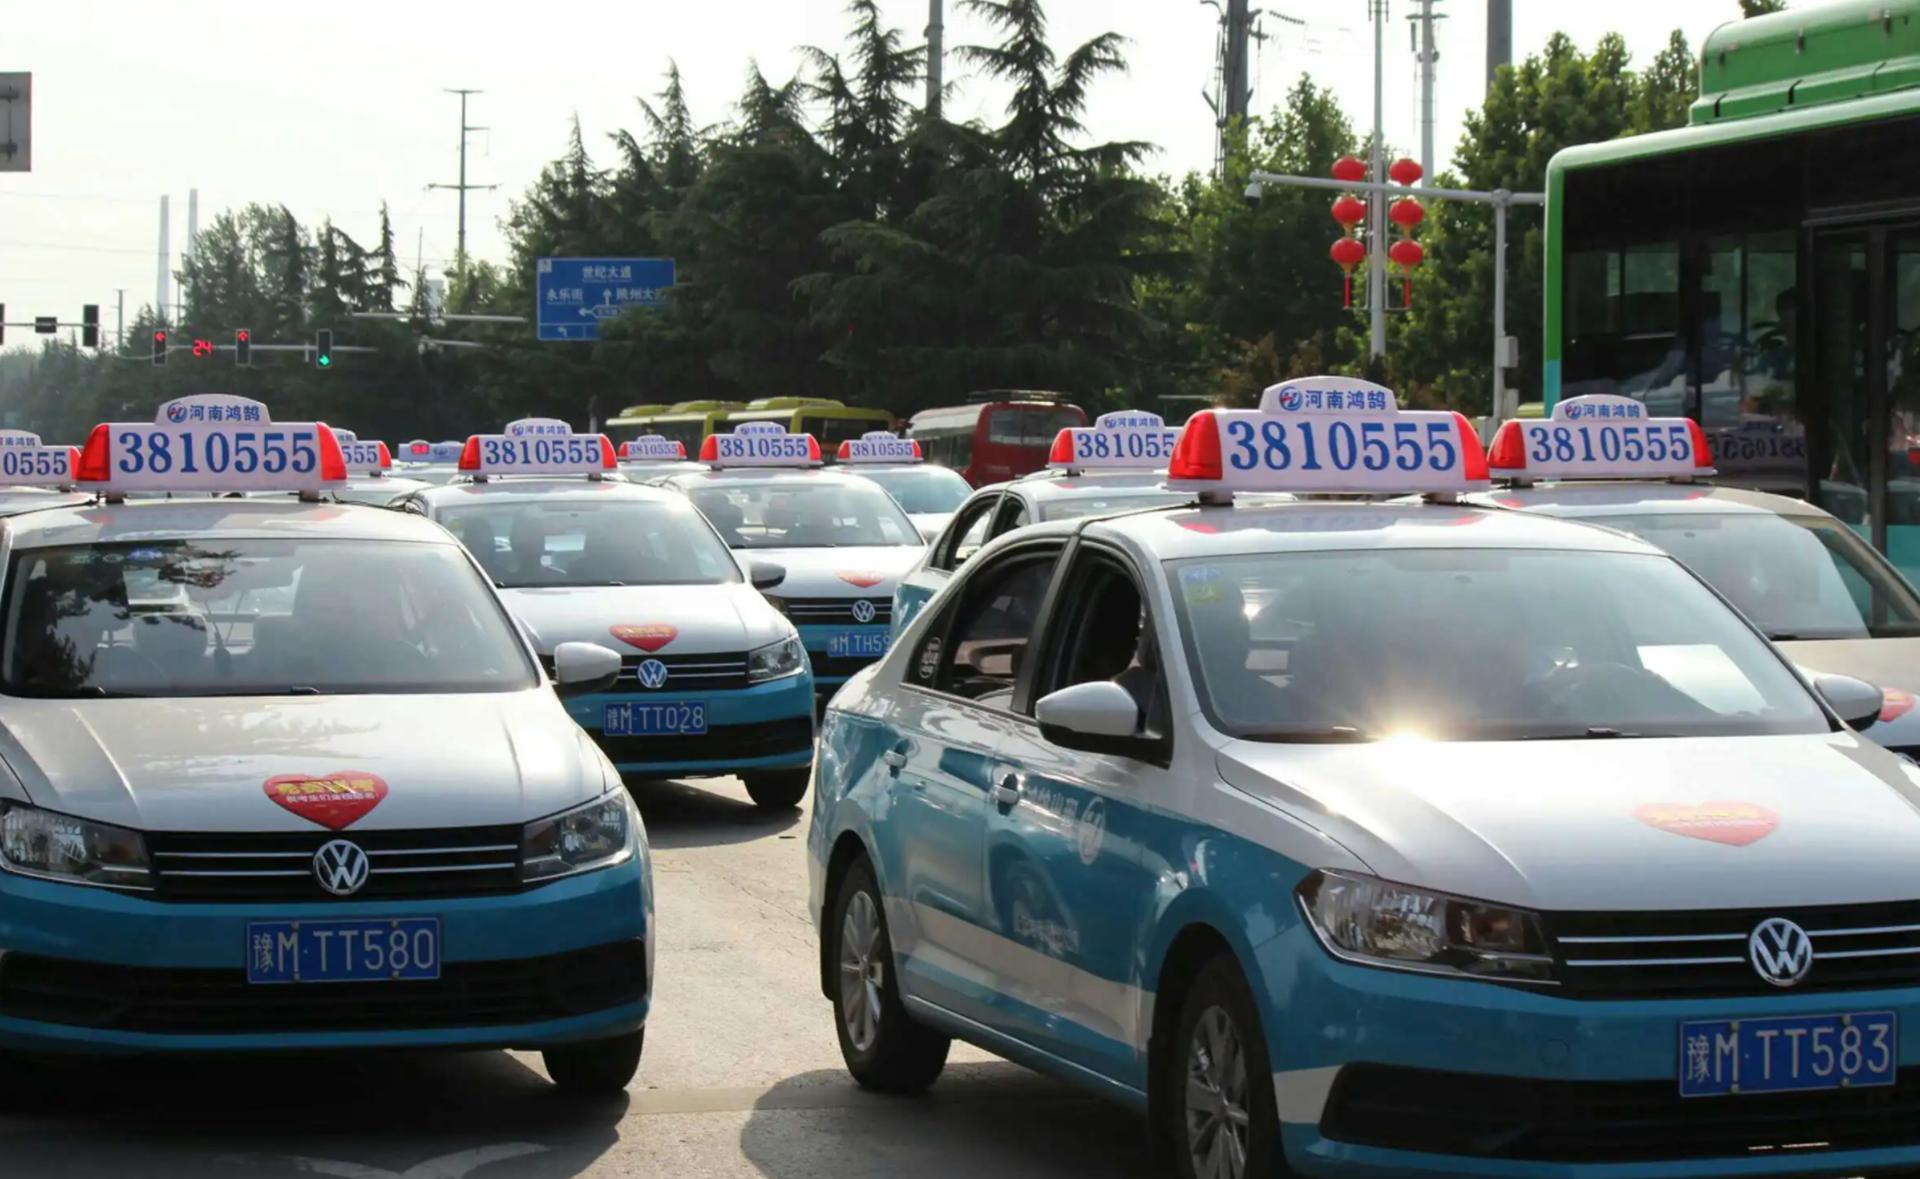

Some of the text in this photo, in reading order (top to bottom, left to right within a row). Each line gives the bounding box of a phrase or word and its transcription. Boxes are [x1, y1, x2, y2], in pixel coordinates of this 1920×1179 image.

[582, 266, 632, 279] 世纪大道
[192, 340, 213, 356] 24
[1305, 389, 1386, 410] 河南鸿鹄
[189, 404, 260, 422] 河南鸿鹄
[1583, 403, 1640, 418] 河南鸿鹄
[118, 431, 317, 474] 3810555
[484, 440, 600, 465] 3810555
[629, 443, 677, 456] 3810555
[720, 438, 808, 458] 3810555
[852, 442, 913, 456] 3810555
[1228, 420, 1457, 471] 3810555
[1529, 425, 1691, 463] 3810555
[3, 451, 68, 476] 0555
